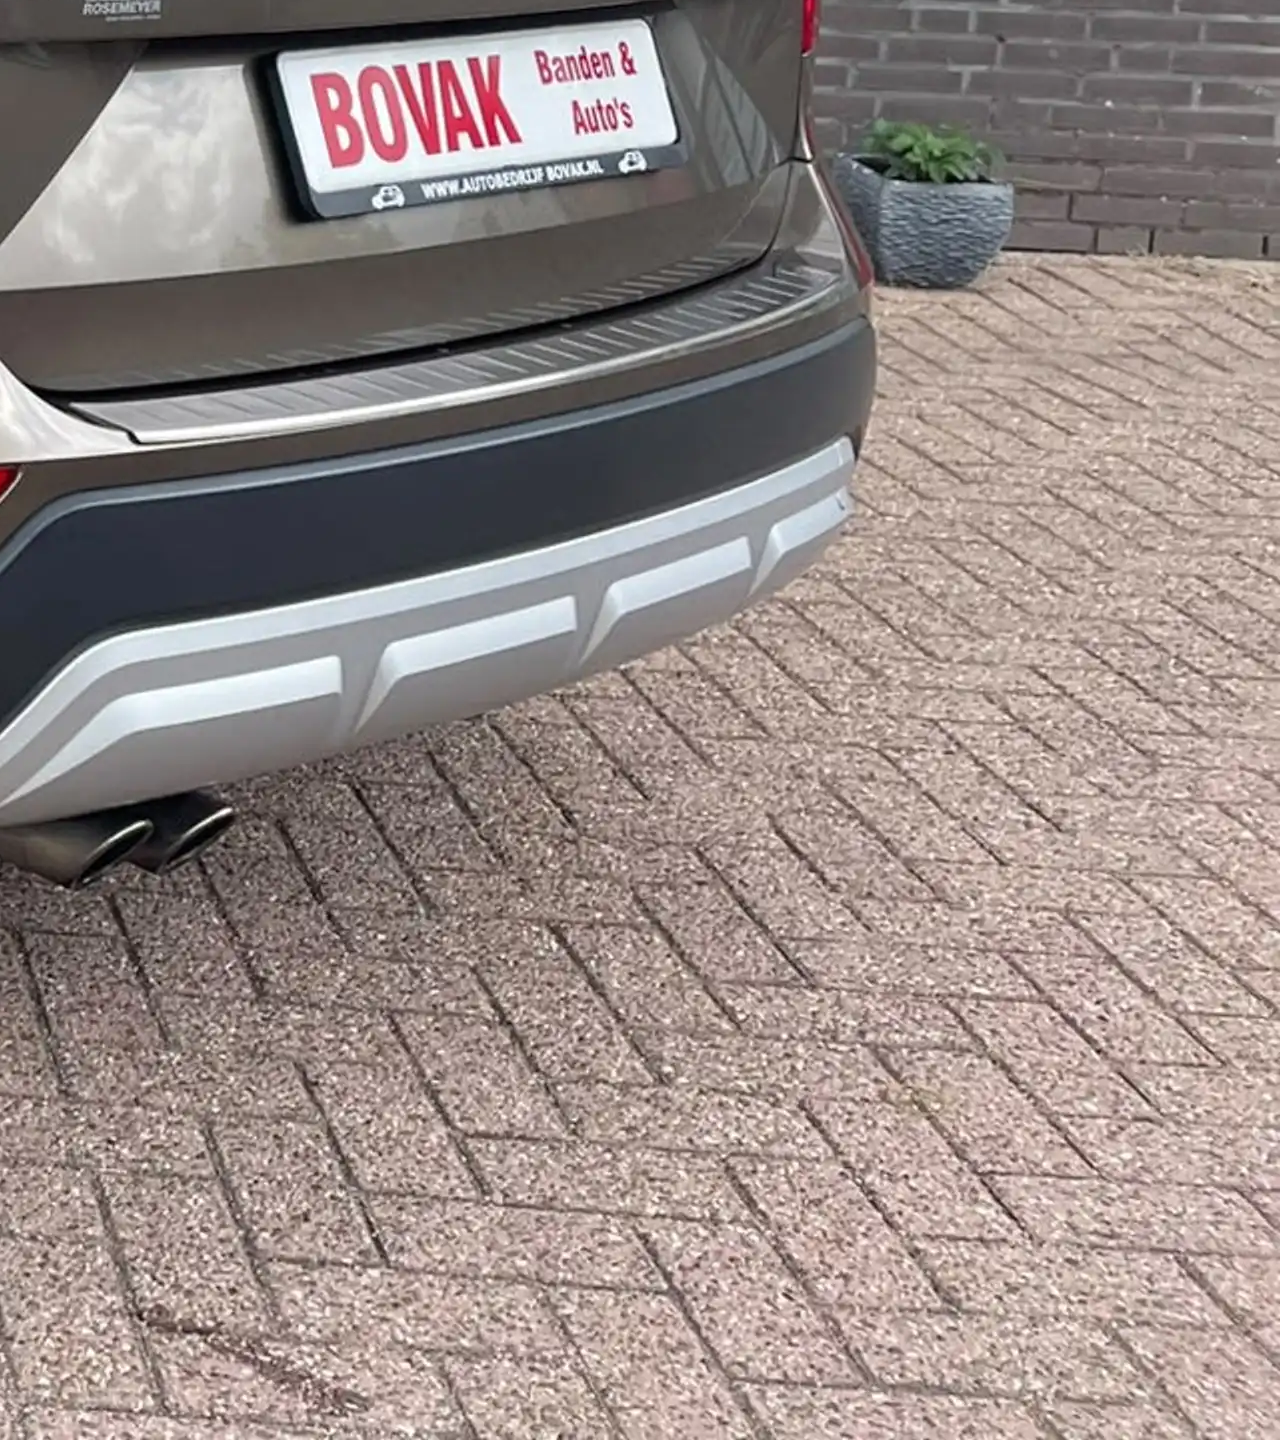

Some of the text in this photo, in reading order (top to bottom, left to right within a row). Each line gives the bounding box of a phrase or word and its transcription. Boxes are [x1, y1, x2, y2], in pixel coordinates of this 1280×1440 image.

[534, 41, 637, 85] Banden &
[310, 55, 523, 168] BOVAK
[571, 98, 634, 135] Auto's
